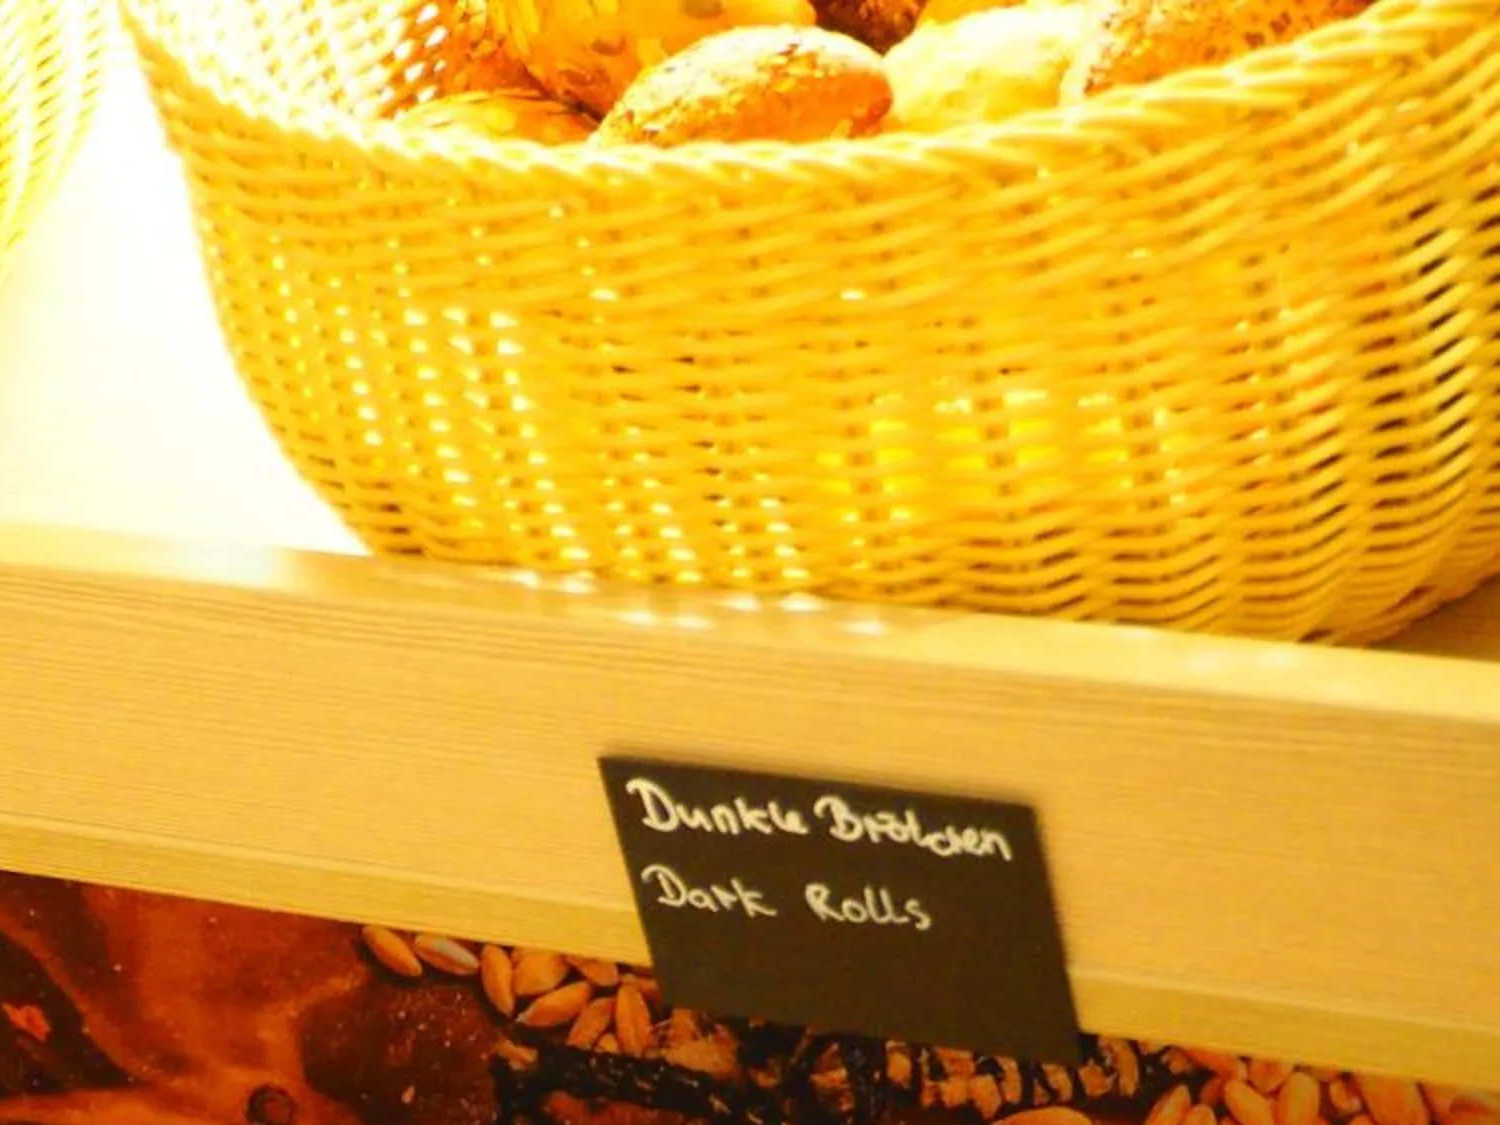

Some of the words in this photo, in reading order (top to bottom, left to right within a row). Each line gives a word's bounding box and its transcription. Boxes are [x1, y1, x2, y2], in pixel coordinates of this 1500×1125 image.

[625, 778, 809, 836] Dunkle
[640, 864, 778, 918] Dark
[804, 882, 931, 931] Rolls
